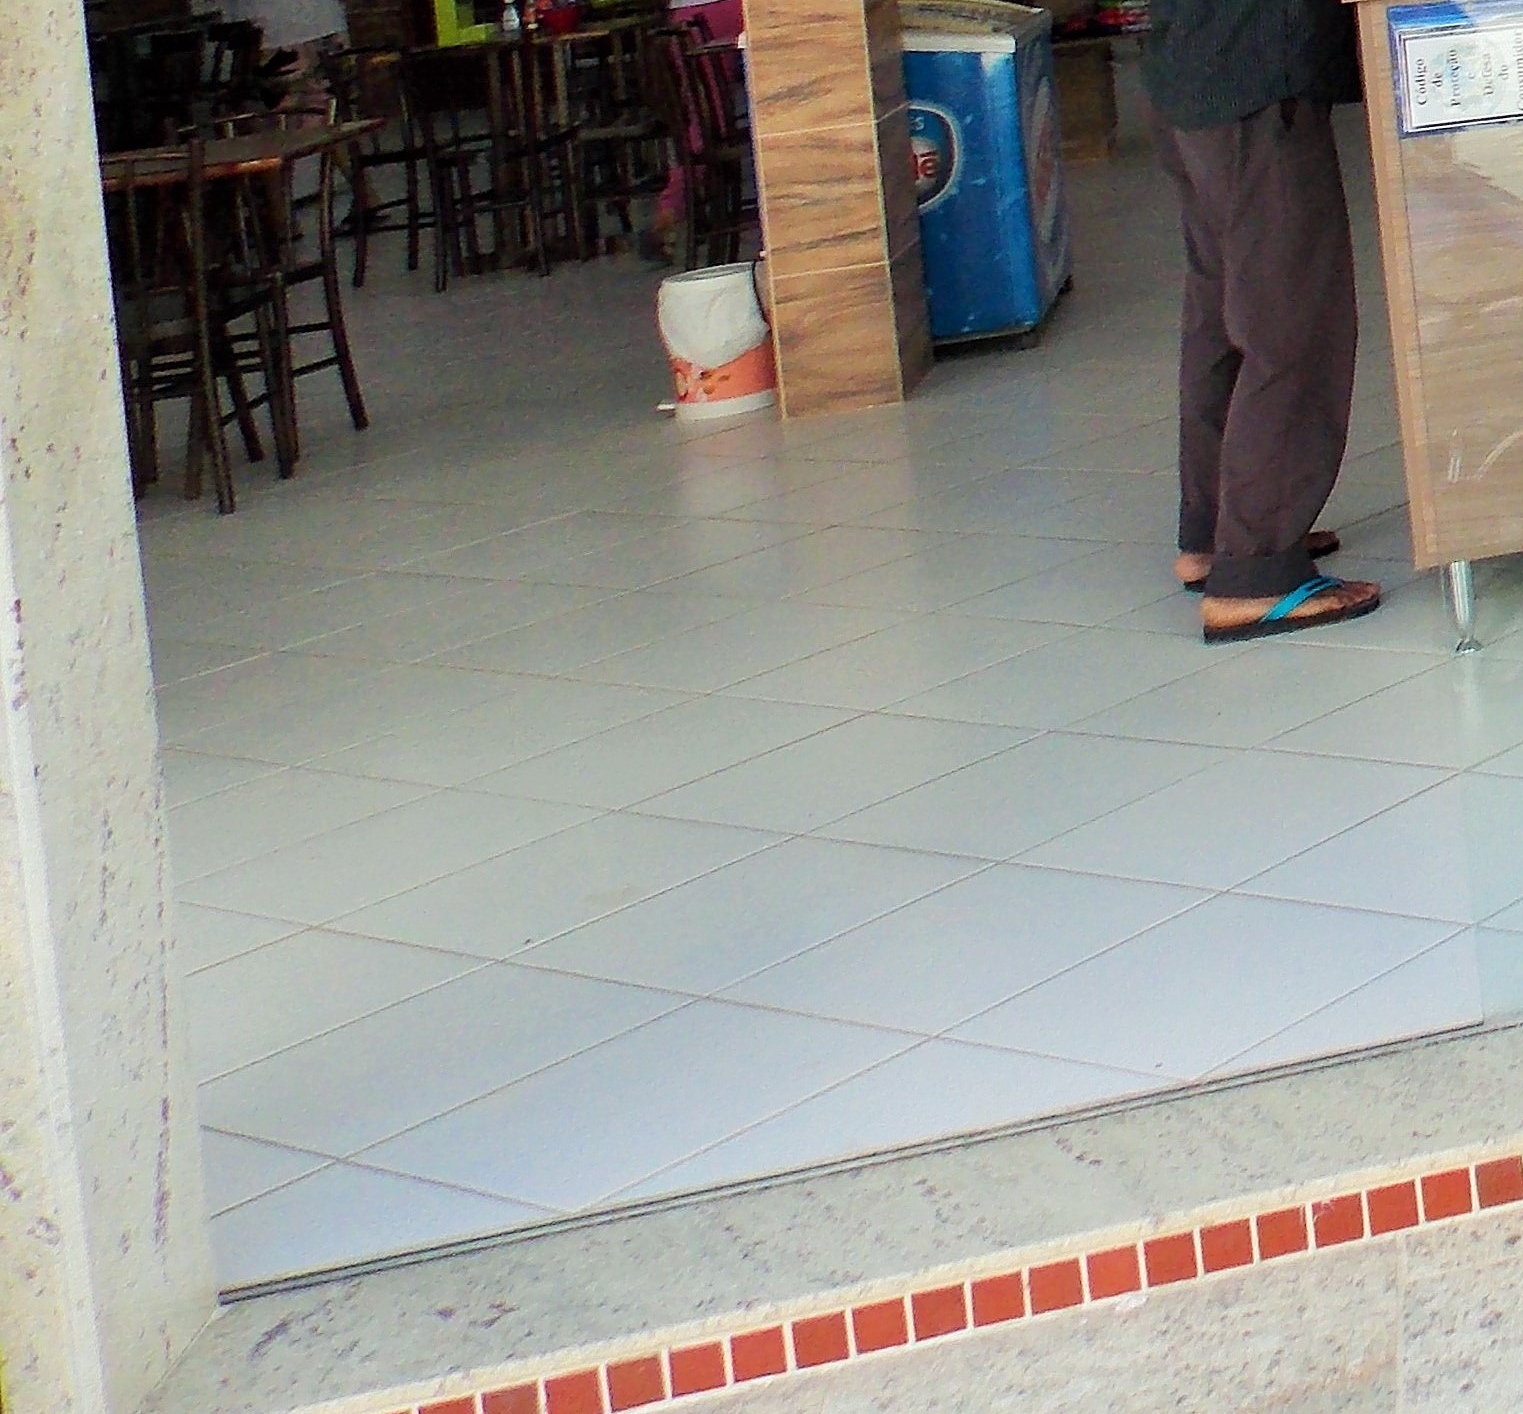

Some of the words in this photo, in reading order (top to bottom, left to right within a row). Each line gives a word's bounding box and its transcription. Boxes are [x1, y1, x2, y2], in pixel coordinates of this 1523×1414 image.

[1414, 58, 1428, 106] Código
[1431, 72, 1443, 87] de
[1446, 48, 1462, 106] Proteção
[1497, 63, 1510, 81] do
